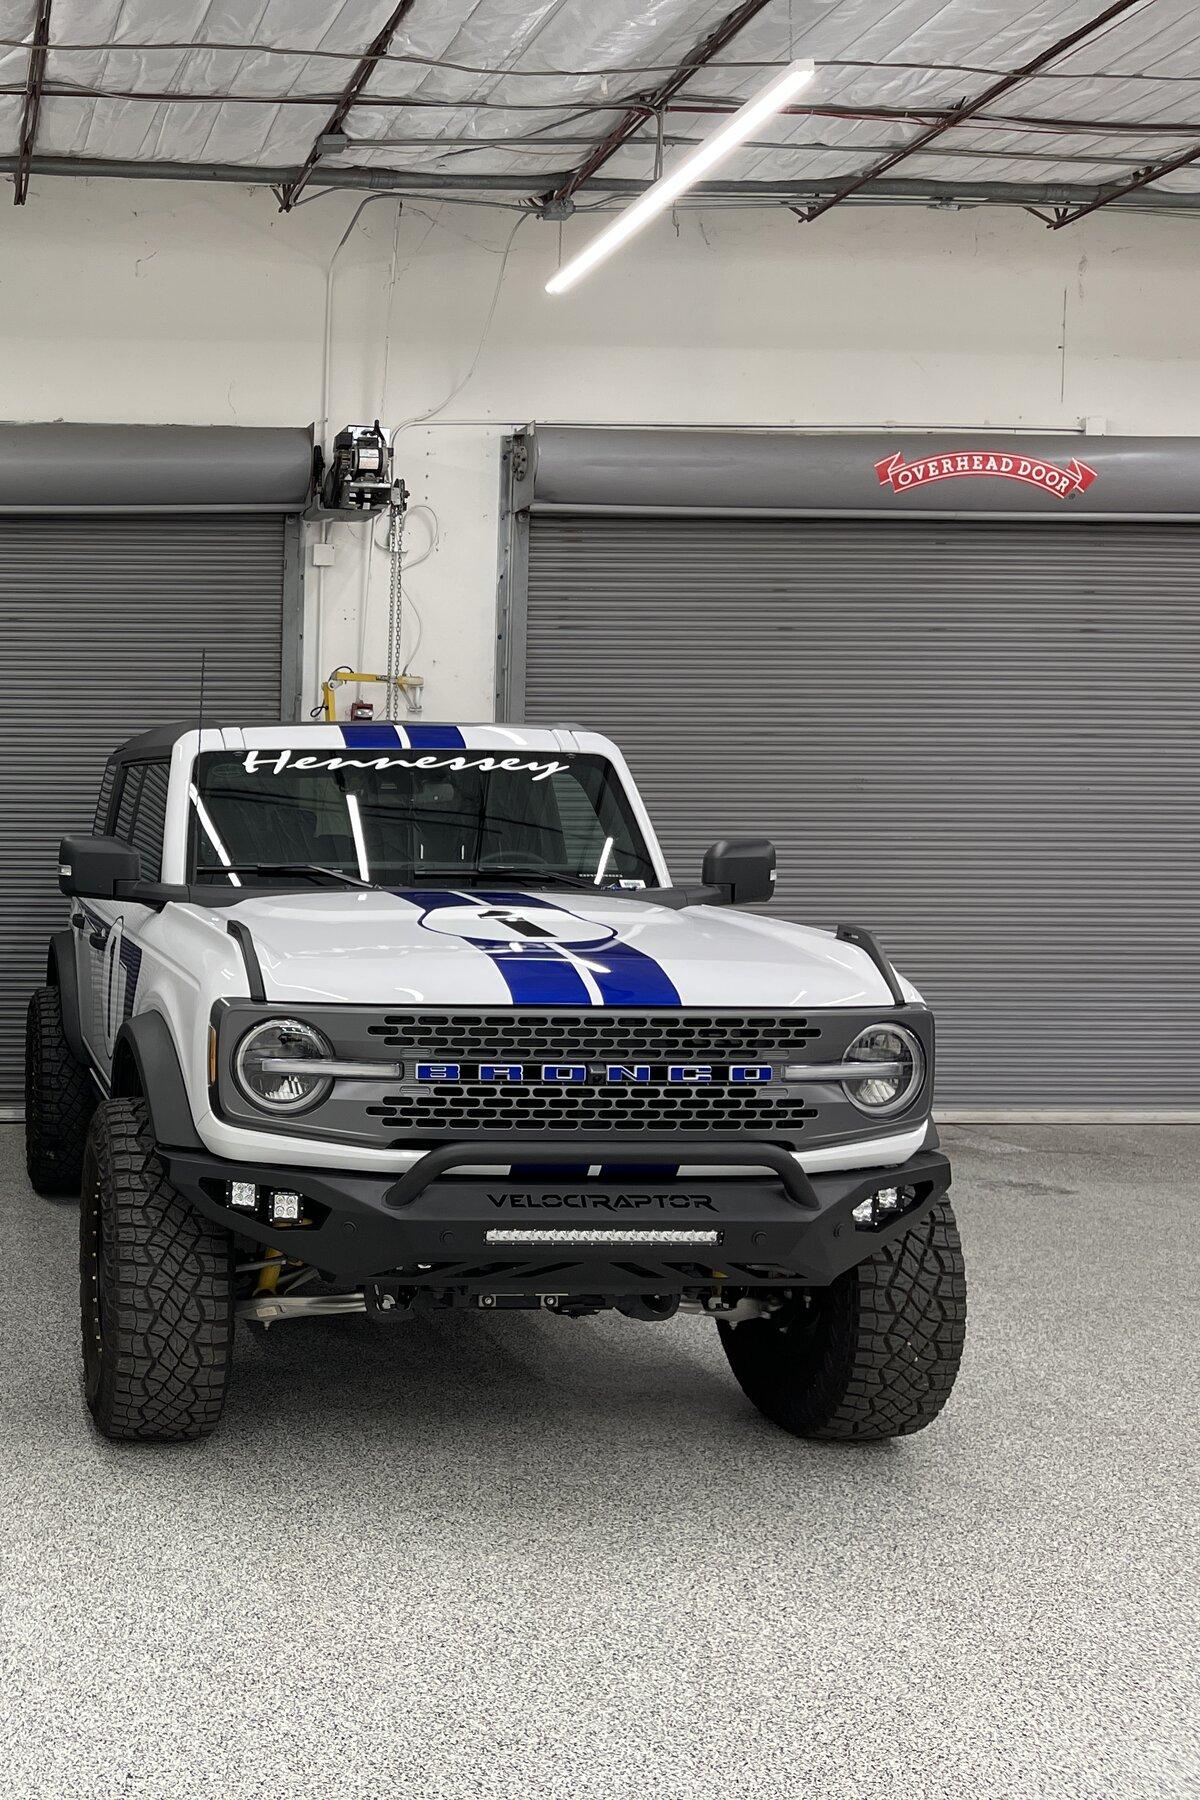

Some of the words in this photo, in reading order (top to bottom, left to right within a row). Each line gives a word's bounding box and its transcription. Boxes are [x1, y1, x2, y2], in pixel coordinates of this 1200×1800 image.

[897, 455, 1013, 485] OVERHEAD
[1017, 460, 1071, 493] DOOR
[242, 749, 572, 781] Hennessey
[477, 910, 559, 938] 1
[415, 1063, 773, 1082] BRONCO
[486, 1193, 721, 1213] VELOCIRAPTOR
